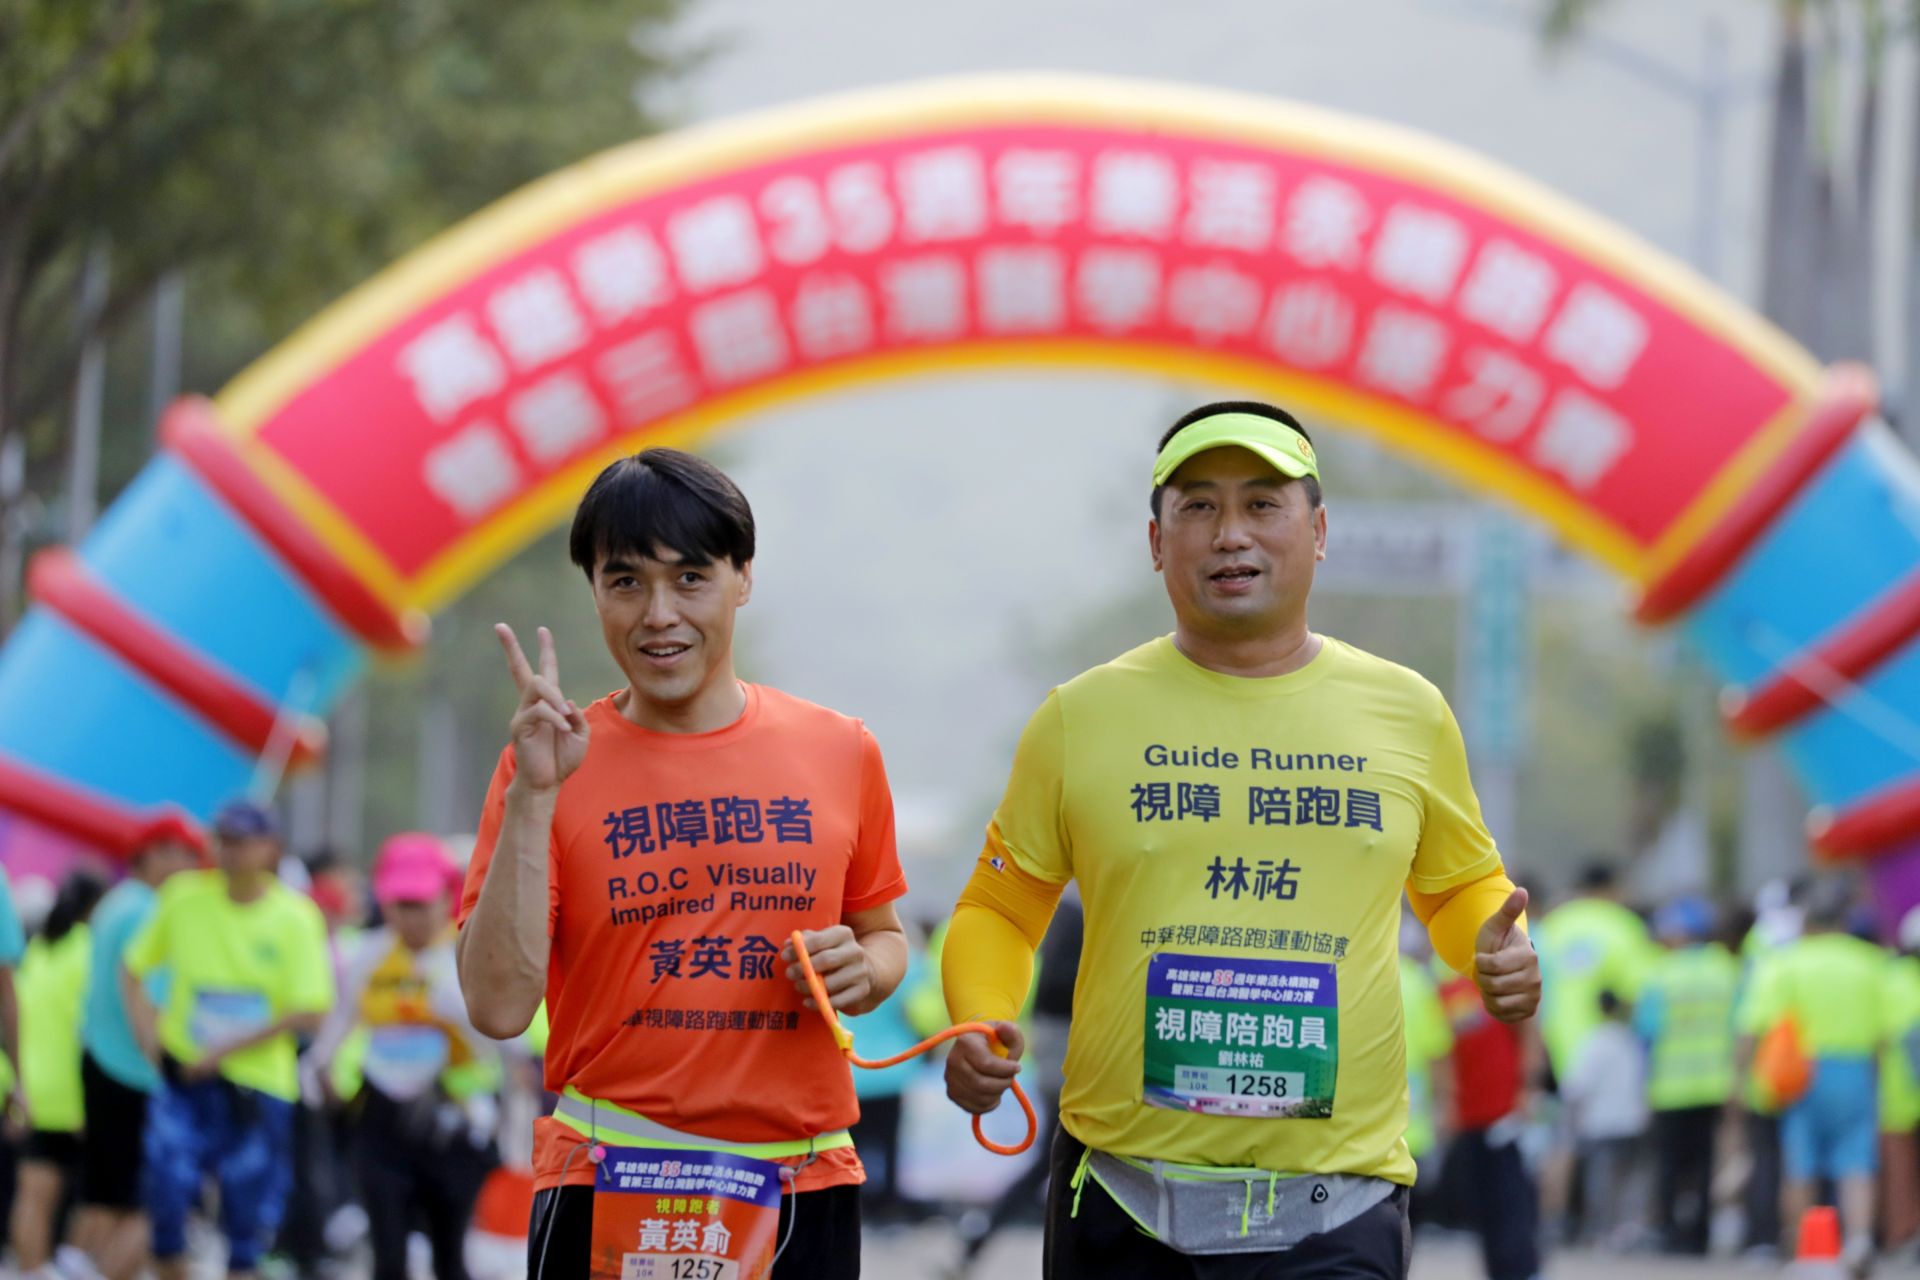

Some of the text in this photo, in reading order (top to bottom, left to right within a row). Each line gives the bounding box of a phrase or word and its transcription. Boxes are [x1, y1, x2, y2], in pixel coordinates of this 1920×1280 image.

[1144, 744, 1367, 772] Guide Runner
[1129, 782, 1383, 832] 視障 陪跑員
[603, 796, 813, 859] 視障跑者
[608, 862, 817, 900] R.O.C Visually
[1205, 856, 1301, 901] 林祐
[611, 891, 816, 926] Impaired Runner
[1141, 925, 1350, 957] 中華視障路跑運動協會
[622, 1008, 800, 1031] 華視障路跑運動協會
[1155, 1006, 1328, 1050] 視障陪跑員
[1218, 1050, 1264, 1068] 劉林祐
[1189, 1082, 1208, 1091] 10K
[1226, 1074, 1287, 1097] 1258
[656, 1198, 721, 1215] 視障跑者
[671, 1258, 724, 1280] 1257
